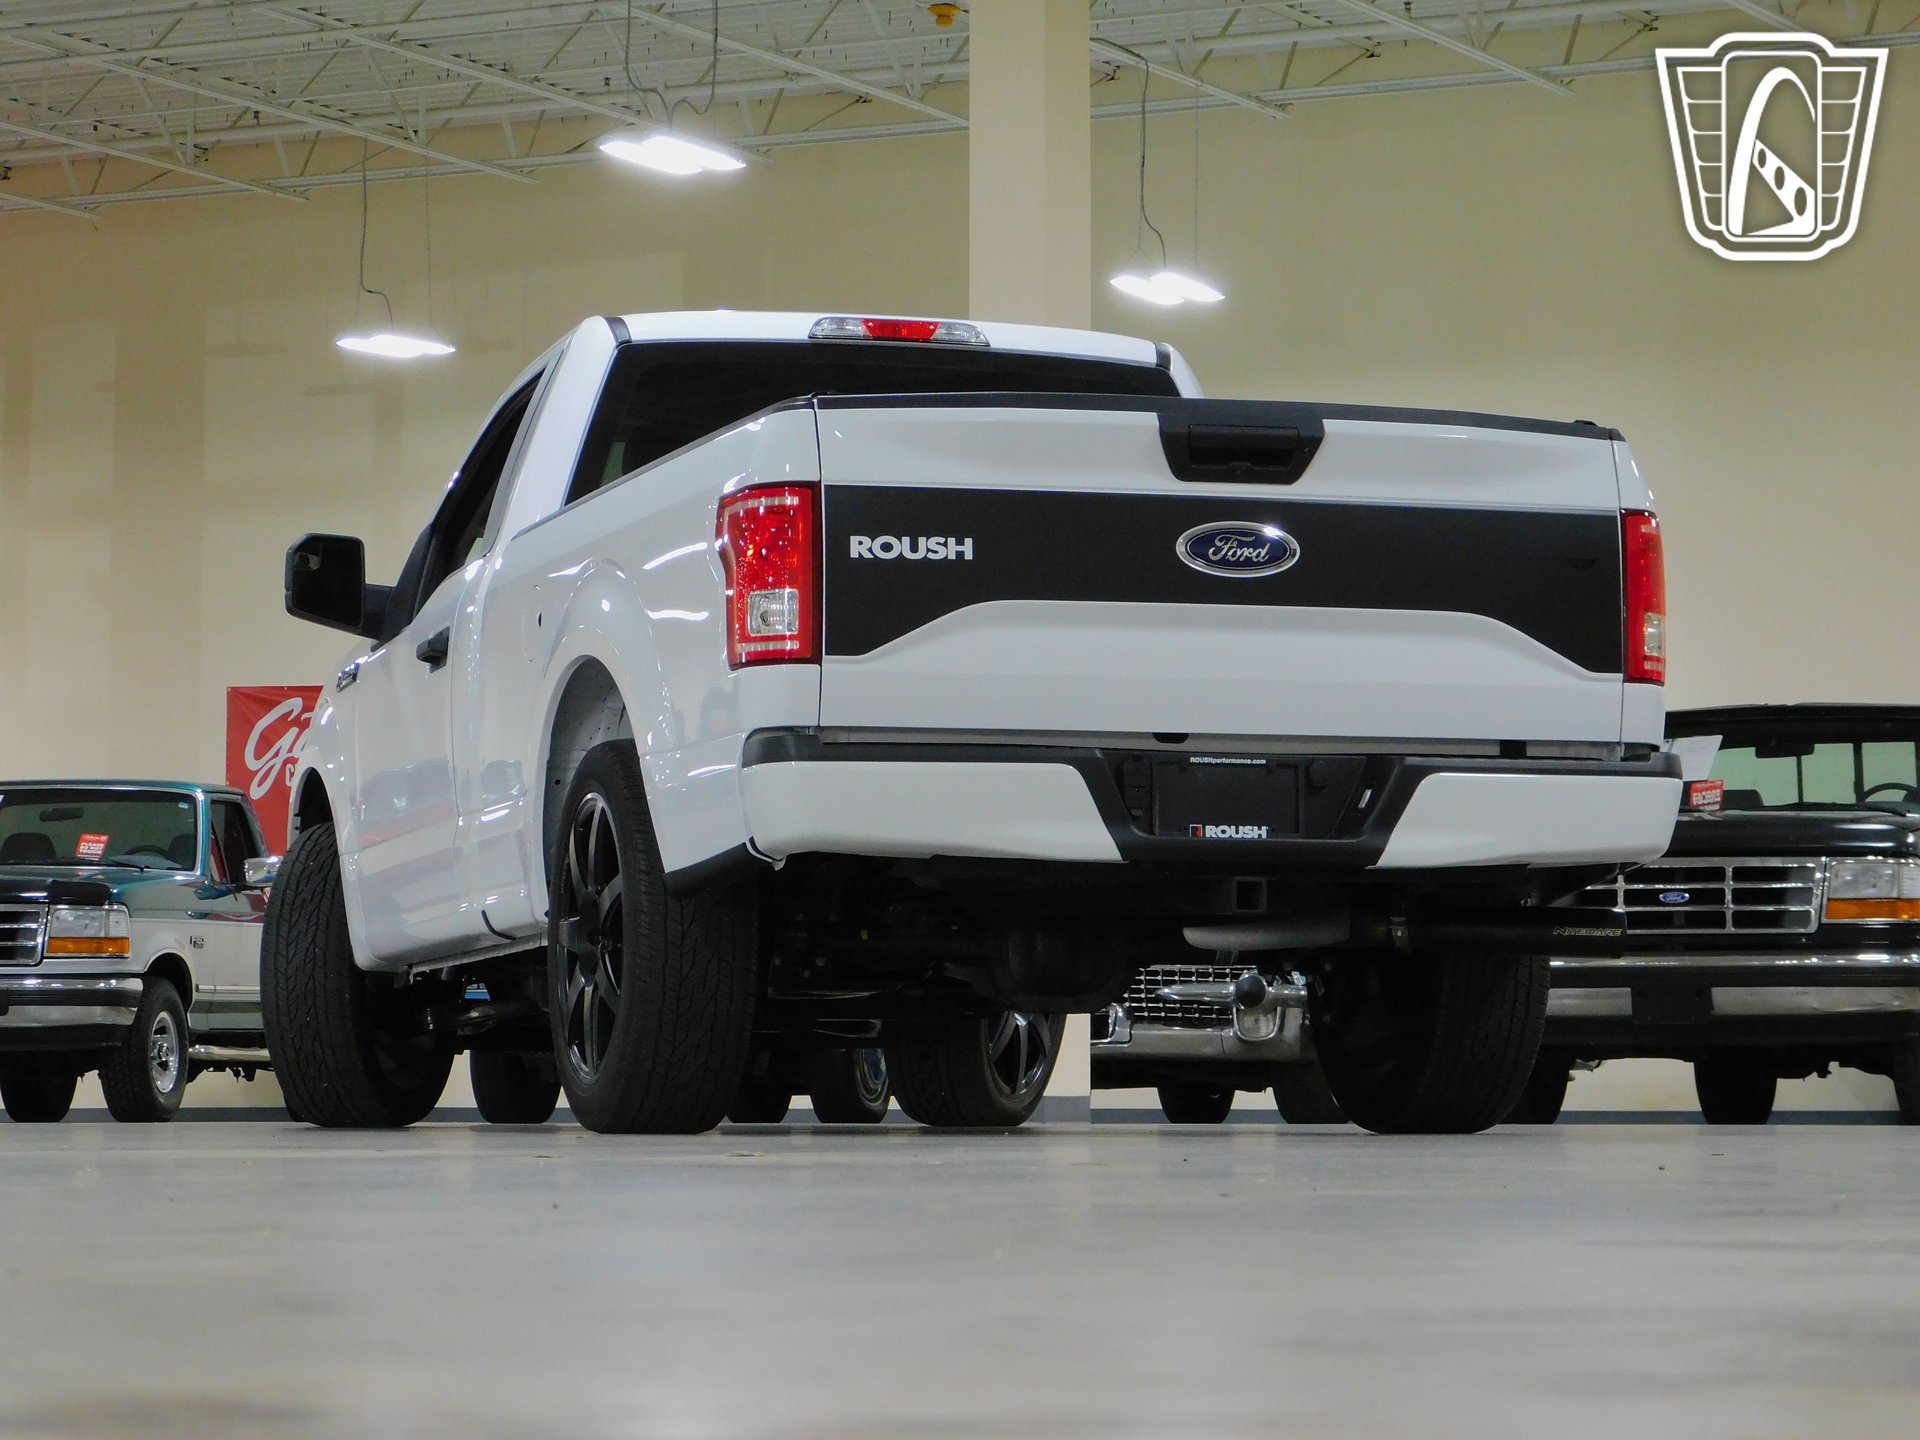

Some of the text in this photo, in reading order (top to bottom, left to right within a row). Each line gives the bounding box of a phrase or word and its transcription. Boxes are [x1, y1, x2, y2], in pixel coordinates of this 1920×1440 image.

[849, 535, 973, 560] ROUSH
[1208, 534, 1271, 562] Ford
[1205, 825, 1267, 838] ROUSH
